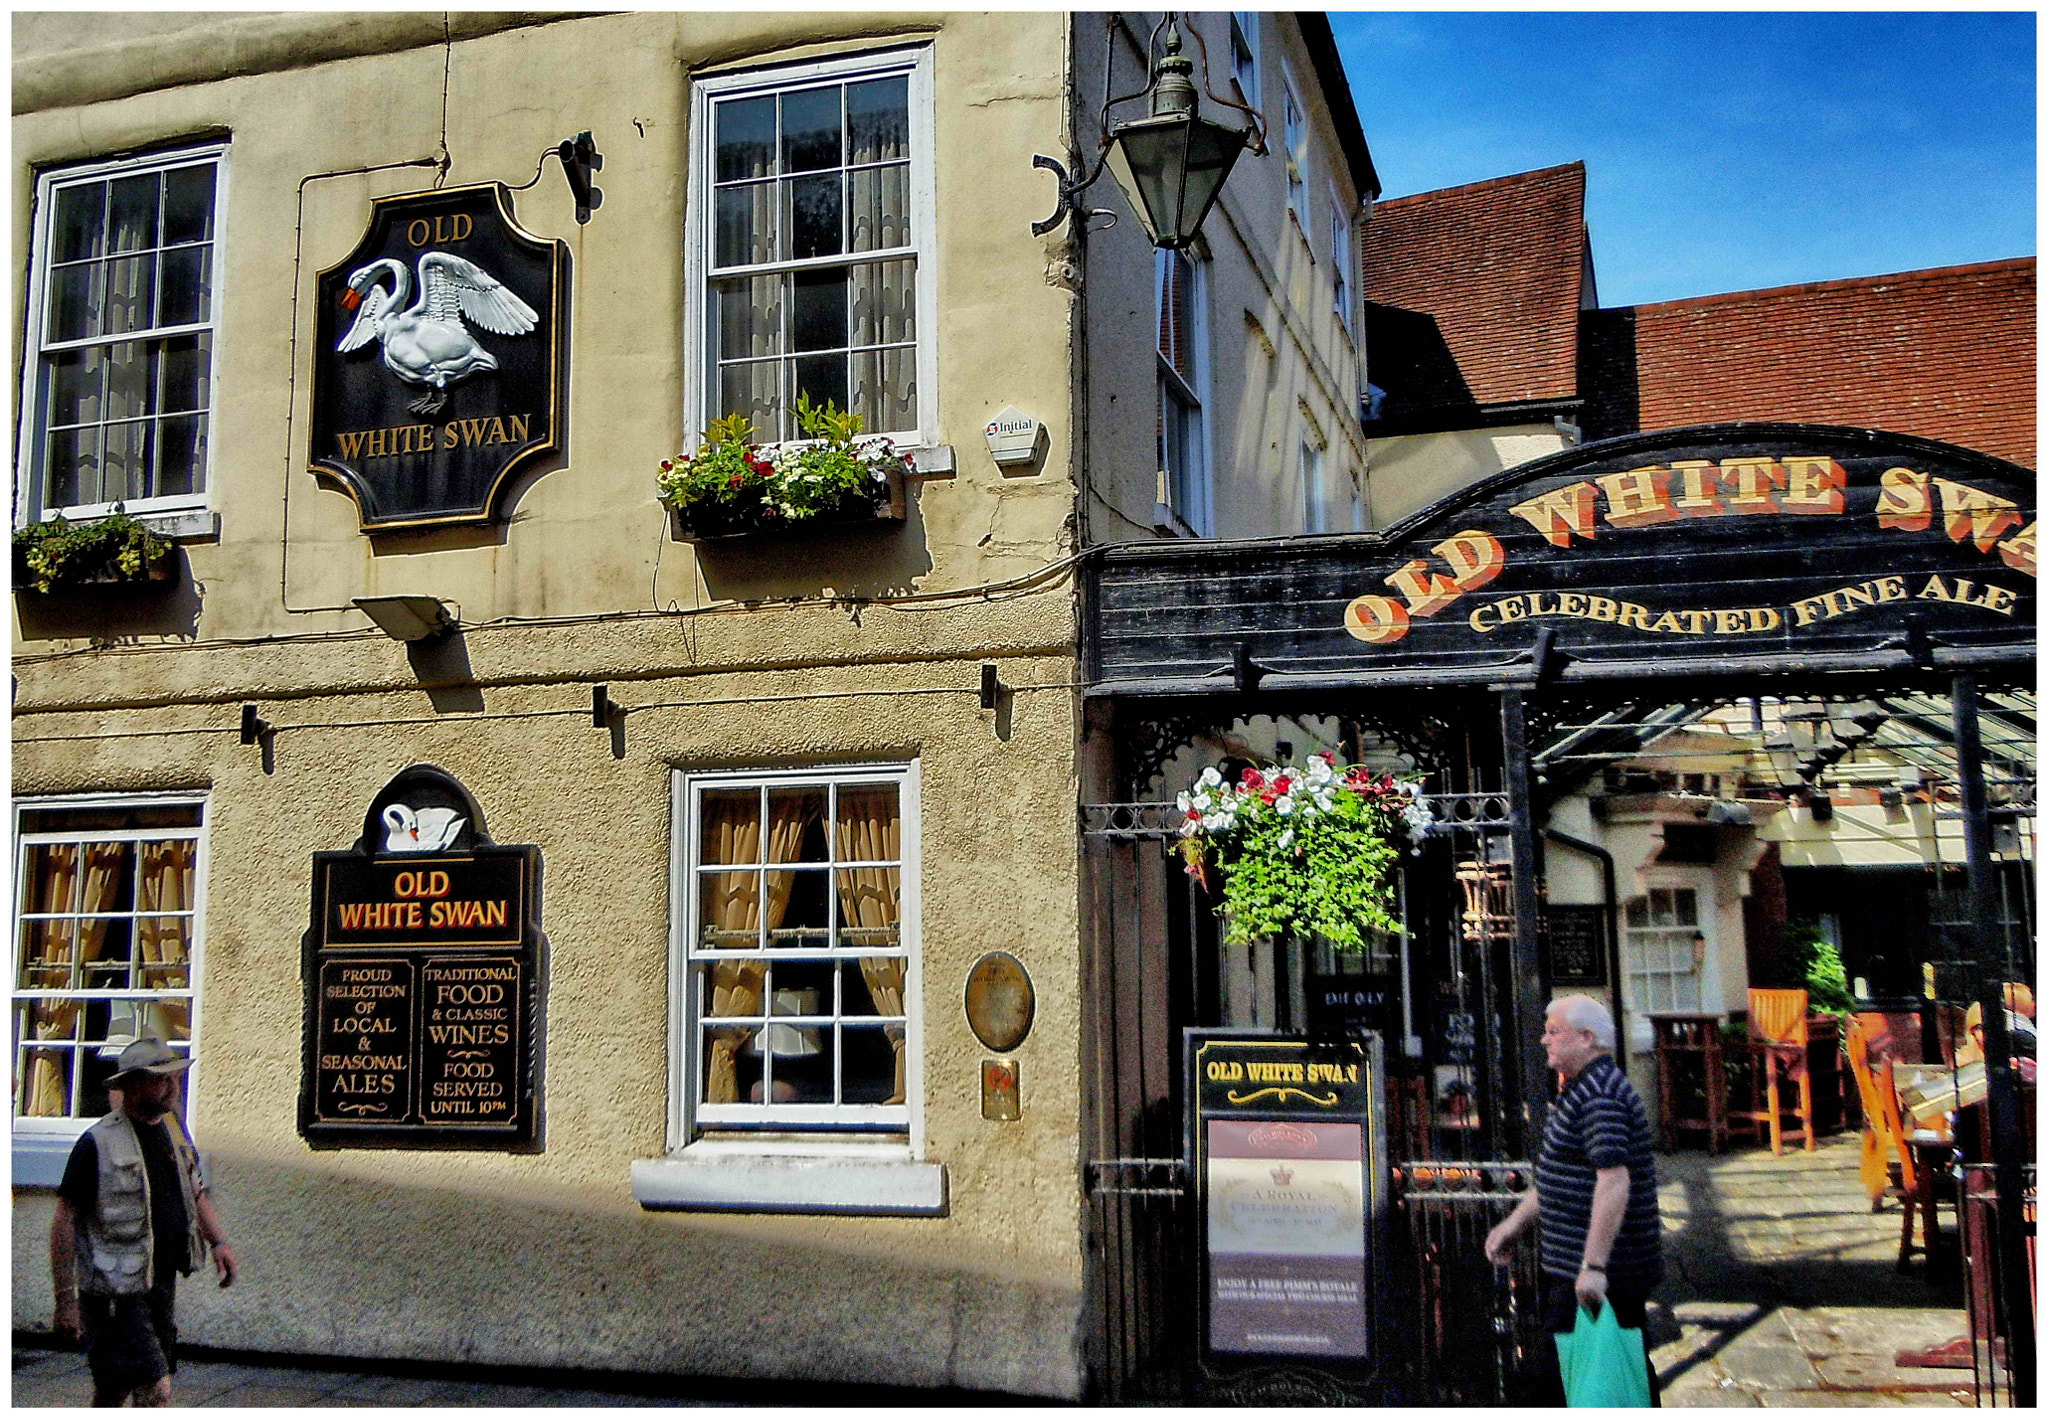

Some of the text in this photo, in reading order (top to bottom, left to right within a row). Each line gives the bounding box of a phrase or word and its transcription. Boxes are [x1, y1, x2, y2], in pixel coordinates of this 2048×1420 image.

[407, 213, 473, 247] OLD
[1000, 419, 1032, 432] Initial
[338, 414, 532, 461] WHITE SWAN
[1344, 529, 1506, 644] OLD
[1509, 455, 1847, 549] WHITE
[1469, 574, 2017, 635] CELEBRATED FINE ALE
[395, 872, 451, 898] OLD
[339, 900, 509, 930] WHITE SWAN
[342, 969, 392, 983] PROUD
[425, 968, 517, 981] TRADITIONAL
[326, 985, 407, 998] SELECTION
[437, 984, 504, 1004] FOOD
[354, 1002, 376, 1014] OF
[432, 1008, 508, 1021] & CLASSIC
[333, 1018, 397, 1034] LOCAL
[428, 1024, 510, 1045] WINES
[358, 1036, 371, 1051] &
[321, 1055, 408, 1071] SEASONAL
[443, 1063, 495, 1079] FOOD
[1206, 1062, 1358, 1084] OLD WHITE SWAN
[331, 1074, 396, 1094] ALES
[432, 1082, 503, 1098] SERVED
[430, 1101, 475, 1115] UNTIL
